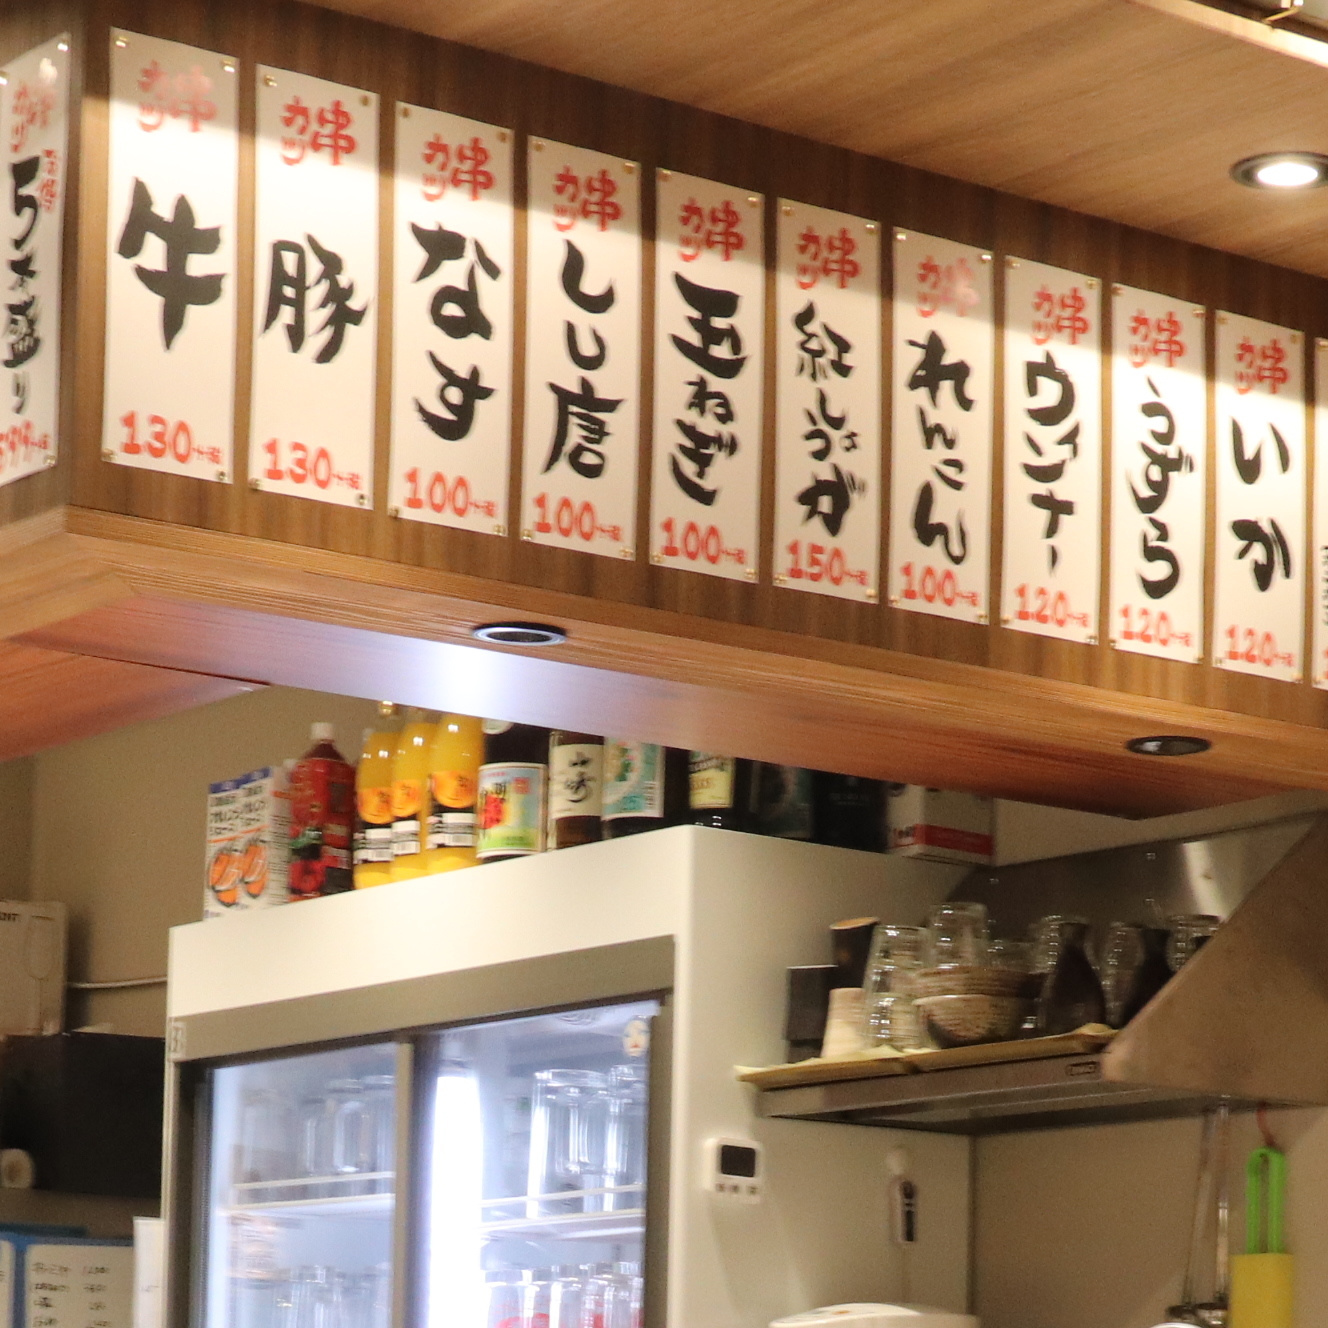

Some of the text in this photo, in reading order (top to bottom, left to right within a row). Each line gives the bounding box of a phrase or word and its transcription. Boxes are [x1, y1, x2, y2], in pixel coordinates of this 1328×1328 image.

[117, 178, 226, 351] 牛
[262, 234, 368, 365] 豚
[411, 223, 501, 442] なす
[542, 240, 624, 480] しし唐
[670, 272, 748, 507] 玉ねぎ
[793, 302, 865, 538] 紅しょうが
[907, 330, 974, 565] れんこん
[1130, 379, 1194, 600] うずら
[1230, 420, 1292, 593] いか
